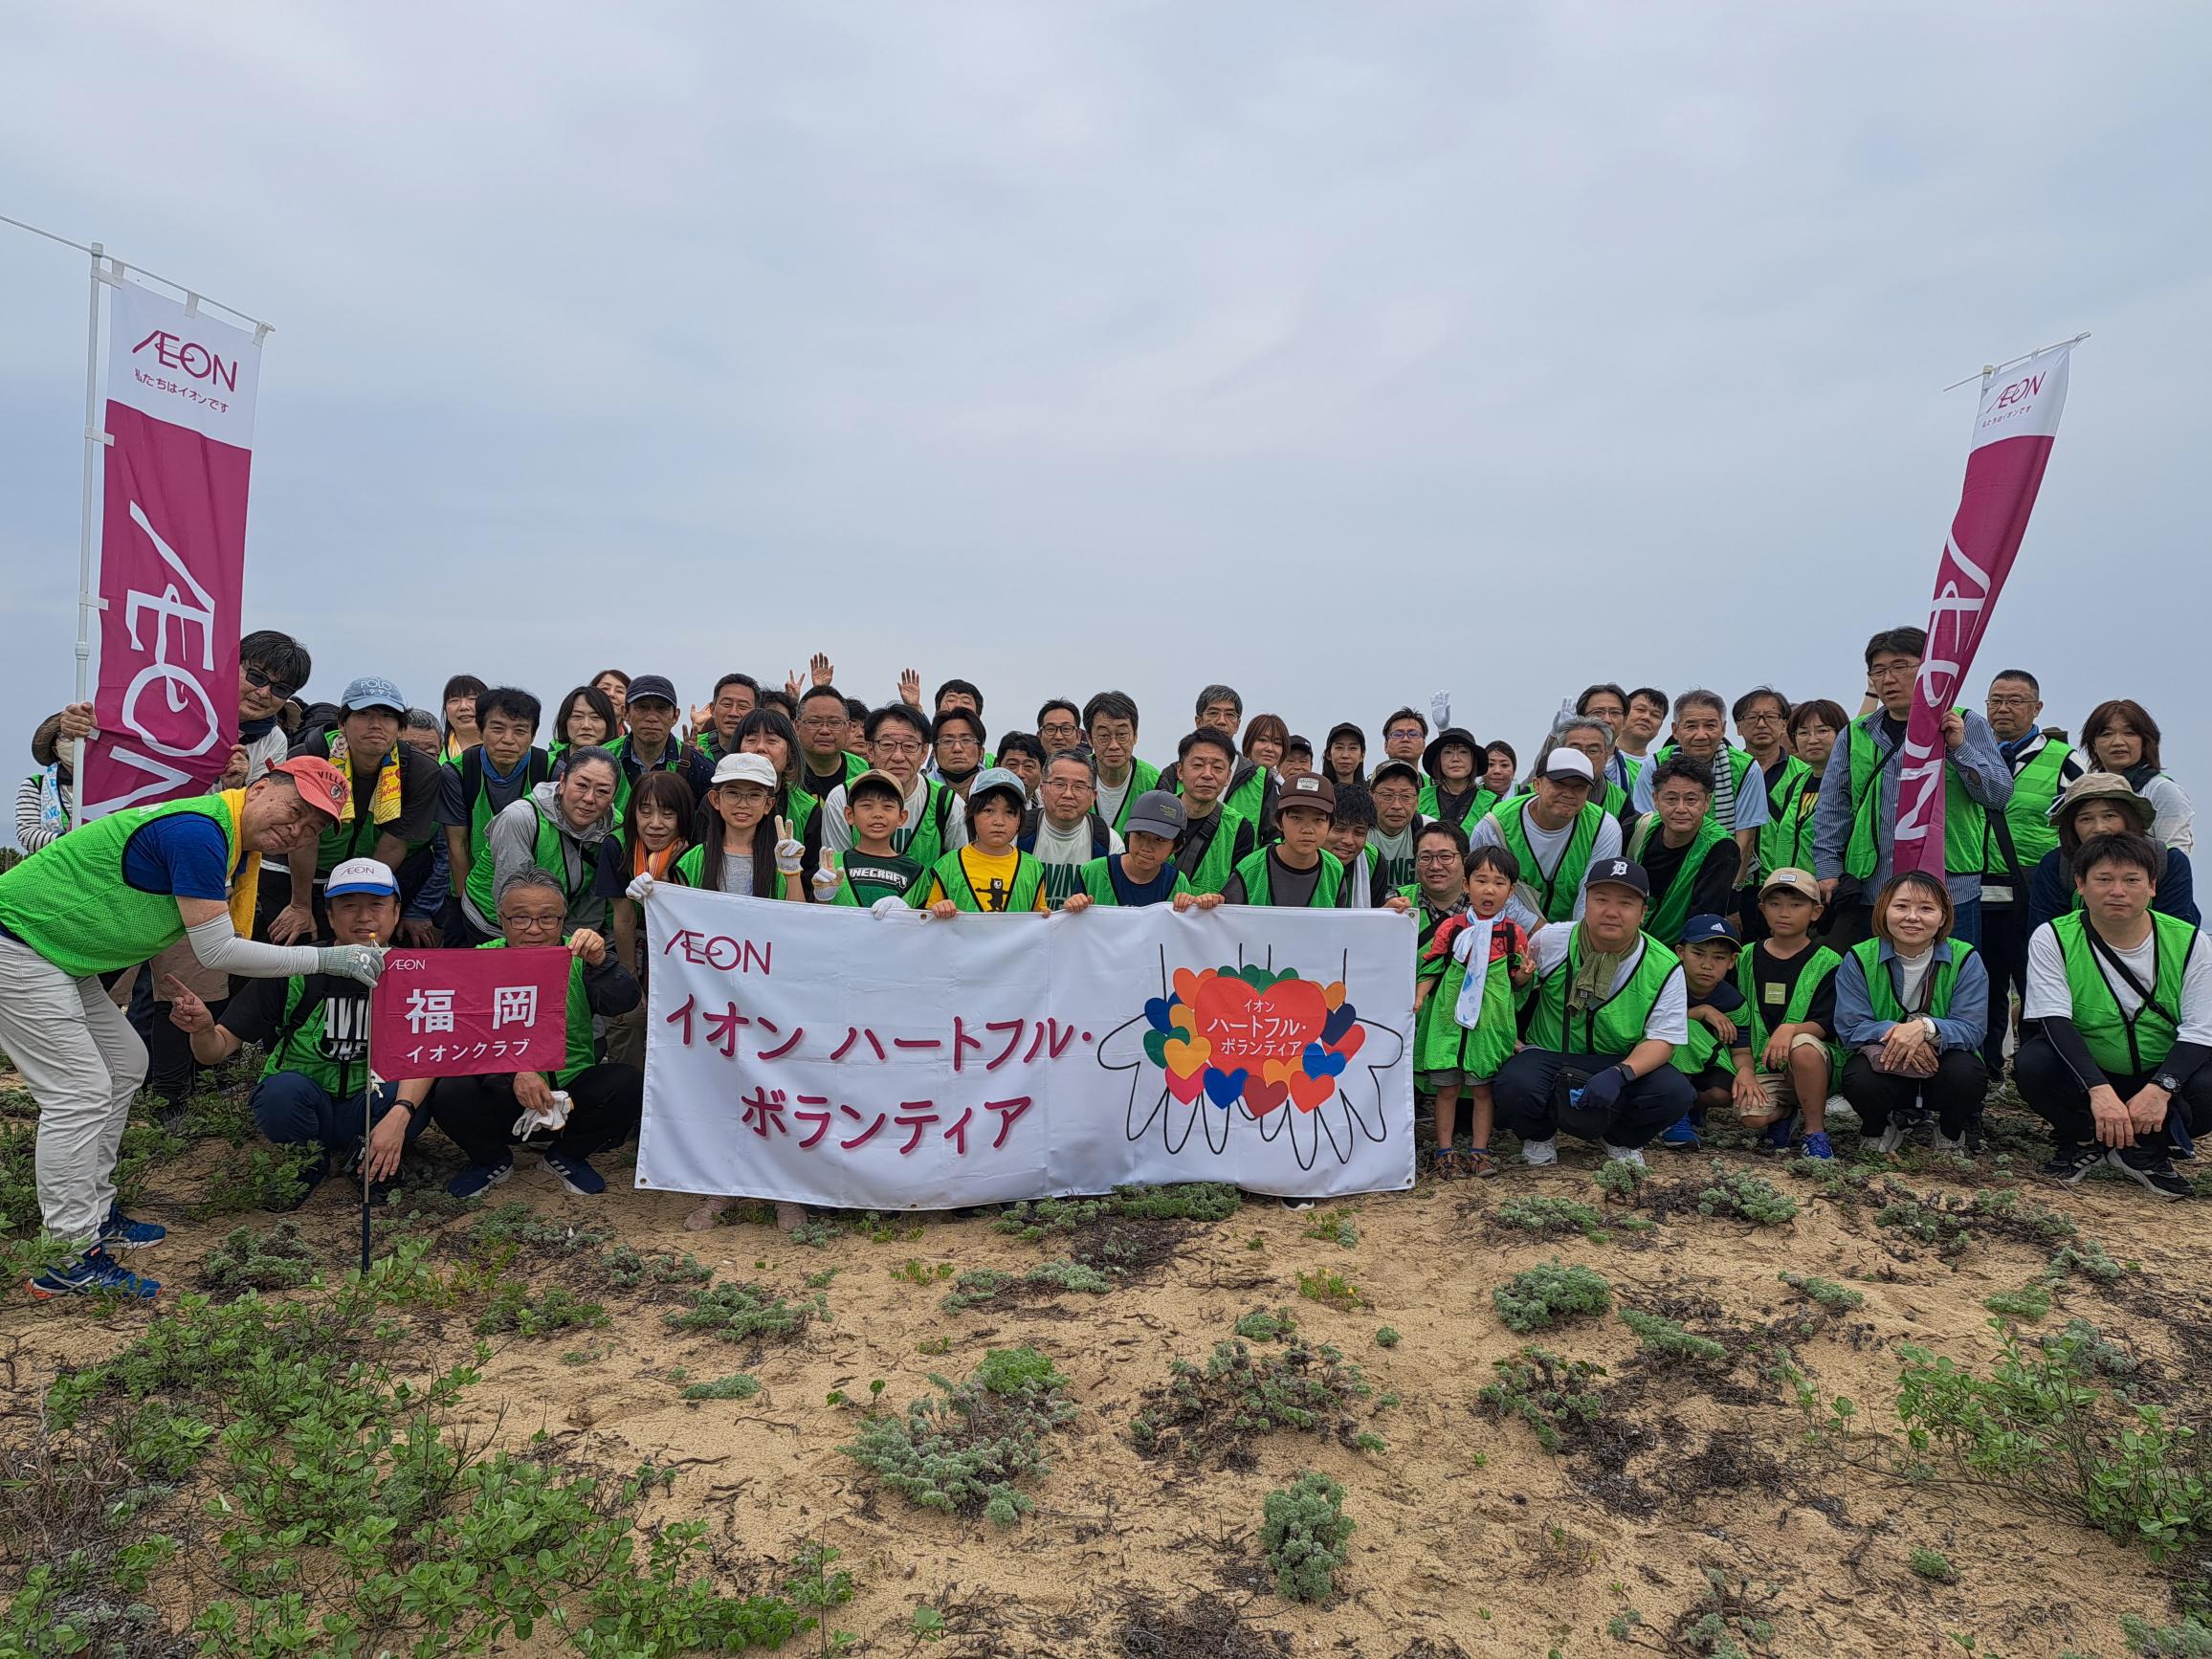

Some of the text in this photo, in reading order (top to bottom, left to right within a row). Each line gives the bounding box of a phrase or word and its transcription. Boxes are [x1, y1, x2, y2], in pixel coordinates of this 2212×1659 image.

[134, 367, 230, 413] 私たちはイオンです
[361, 679, 392, 690] POLO
[1244, 998, 1275, 1013] イオン
[666, 993, 804, 1060] イオン
[406, 1039, 531, 1064] イオンクラブ
[1220, 1037, 1302, 1056] ボランティア
[741, 1085, 1033, 1156] ボランティア
